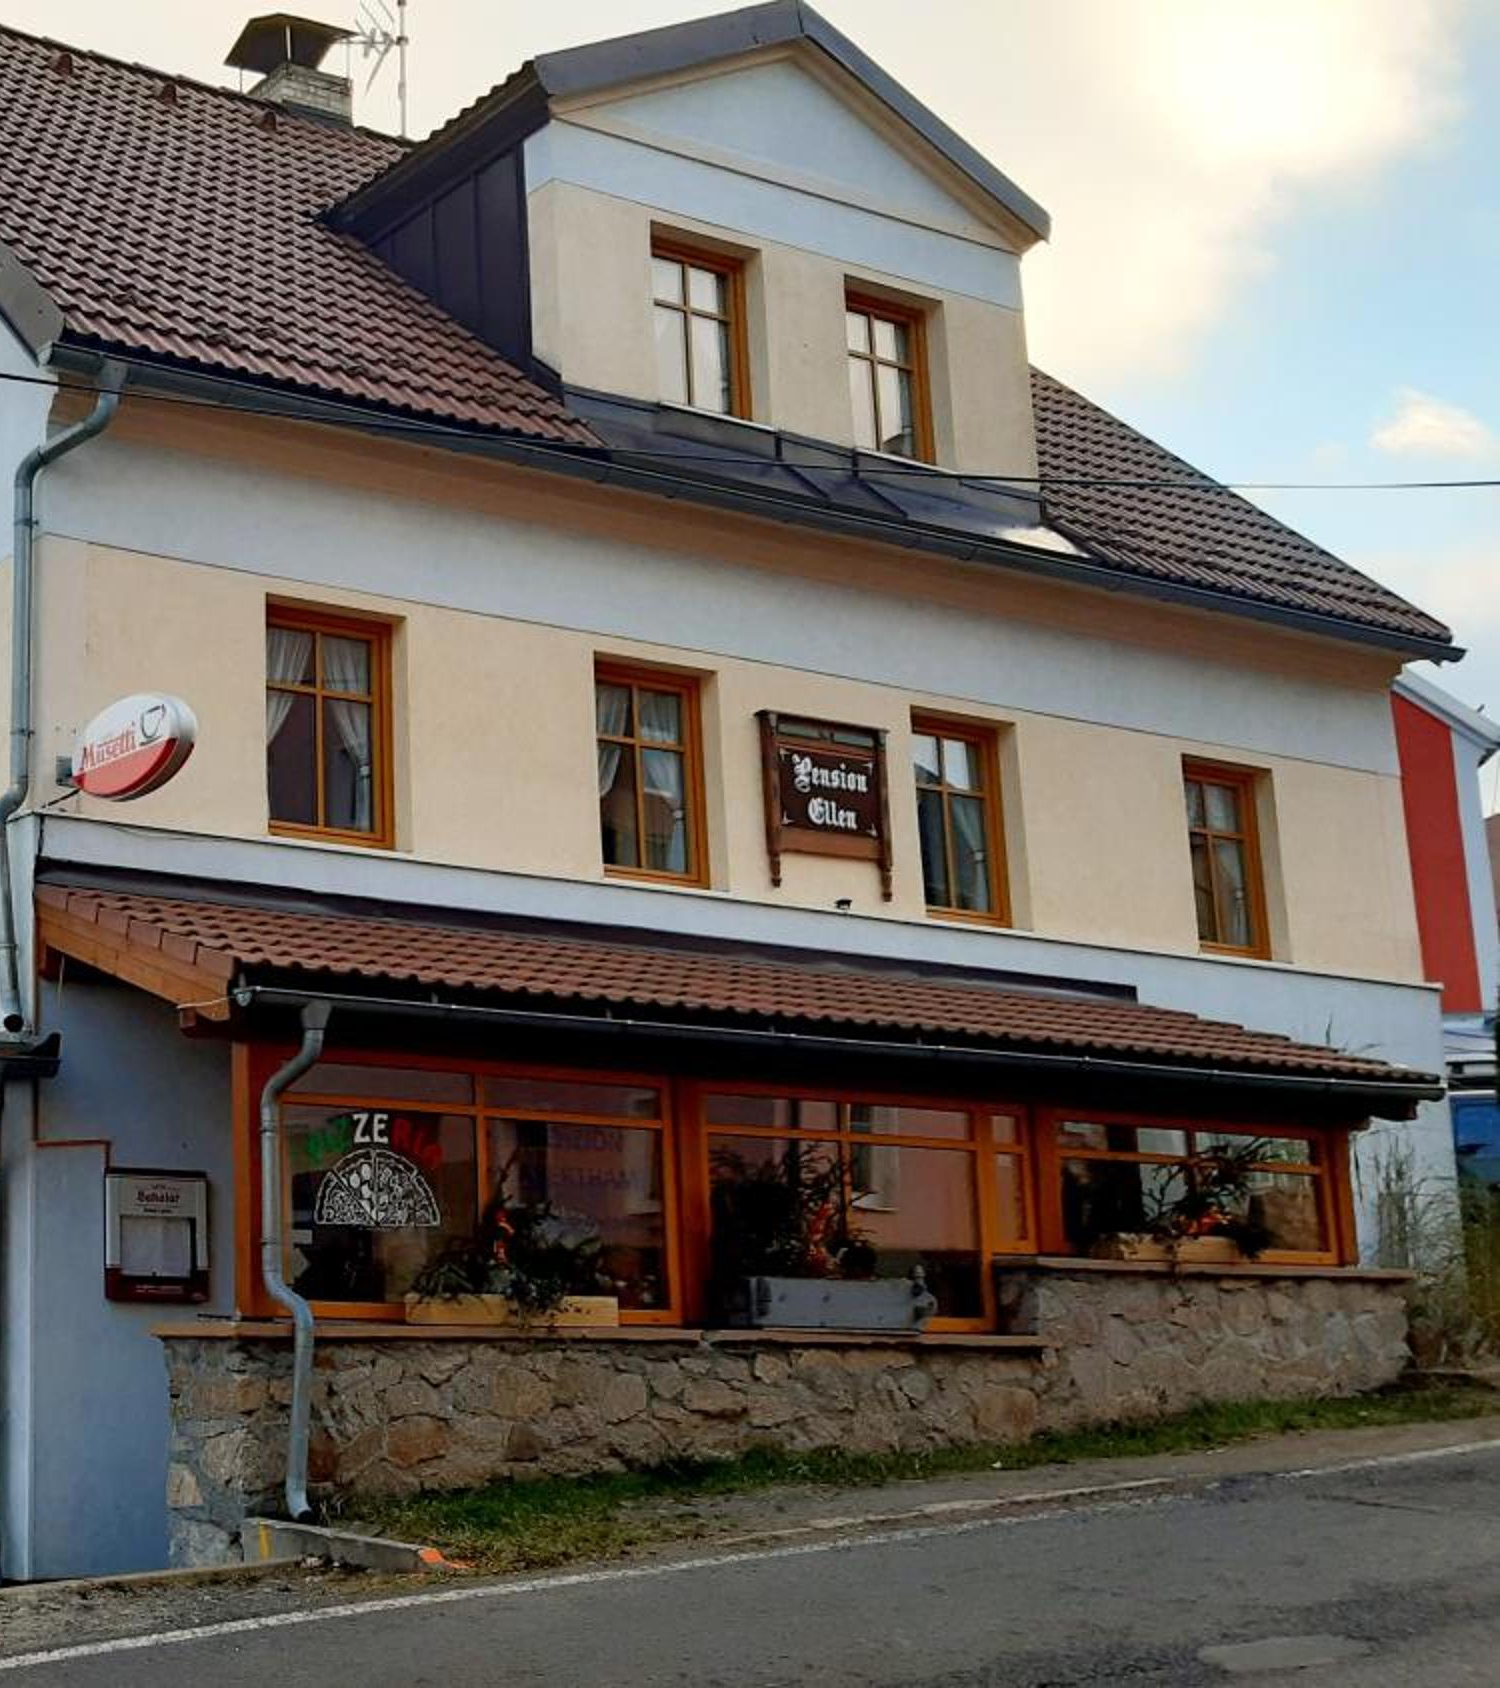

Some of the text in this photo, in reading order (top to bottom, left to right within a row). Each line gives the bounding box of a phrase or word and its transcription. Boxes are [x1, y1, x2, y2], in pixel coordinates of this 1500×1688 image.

[80, 721, 137, 771] Musetti
[792, 753, 868, 793] Pension
[807, 797, 858, 829] Ellen
